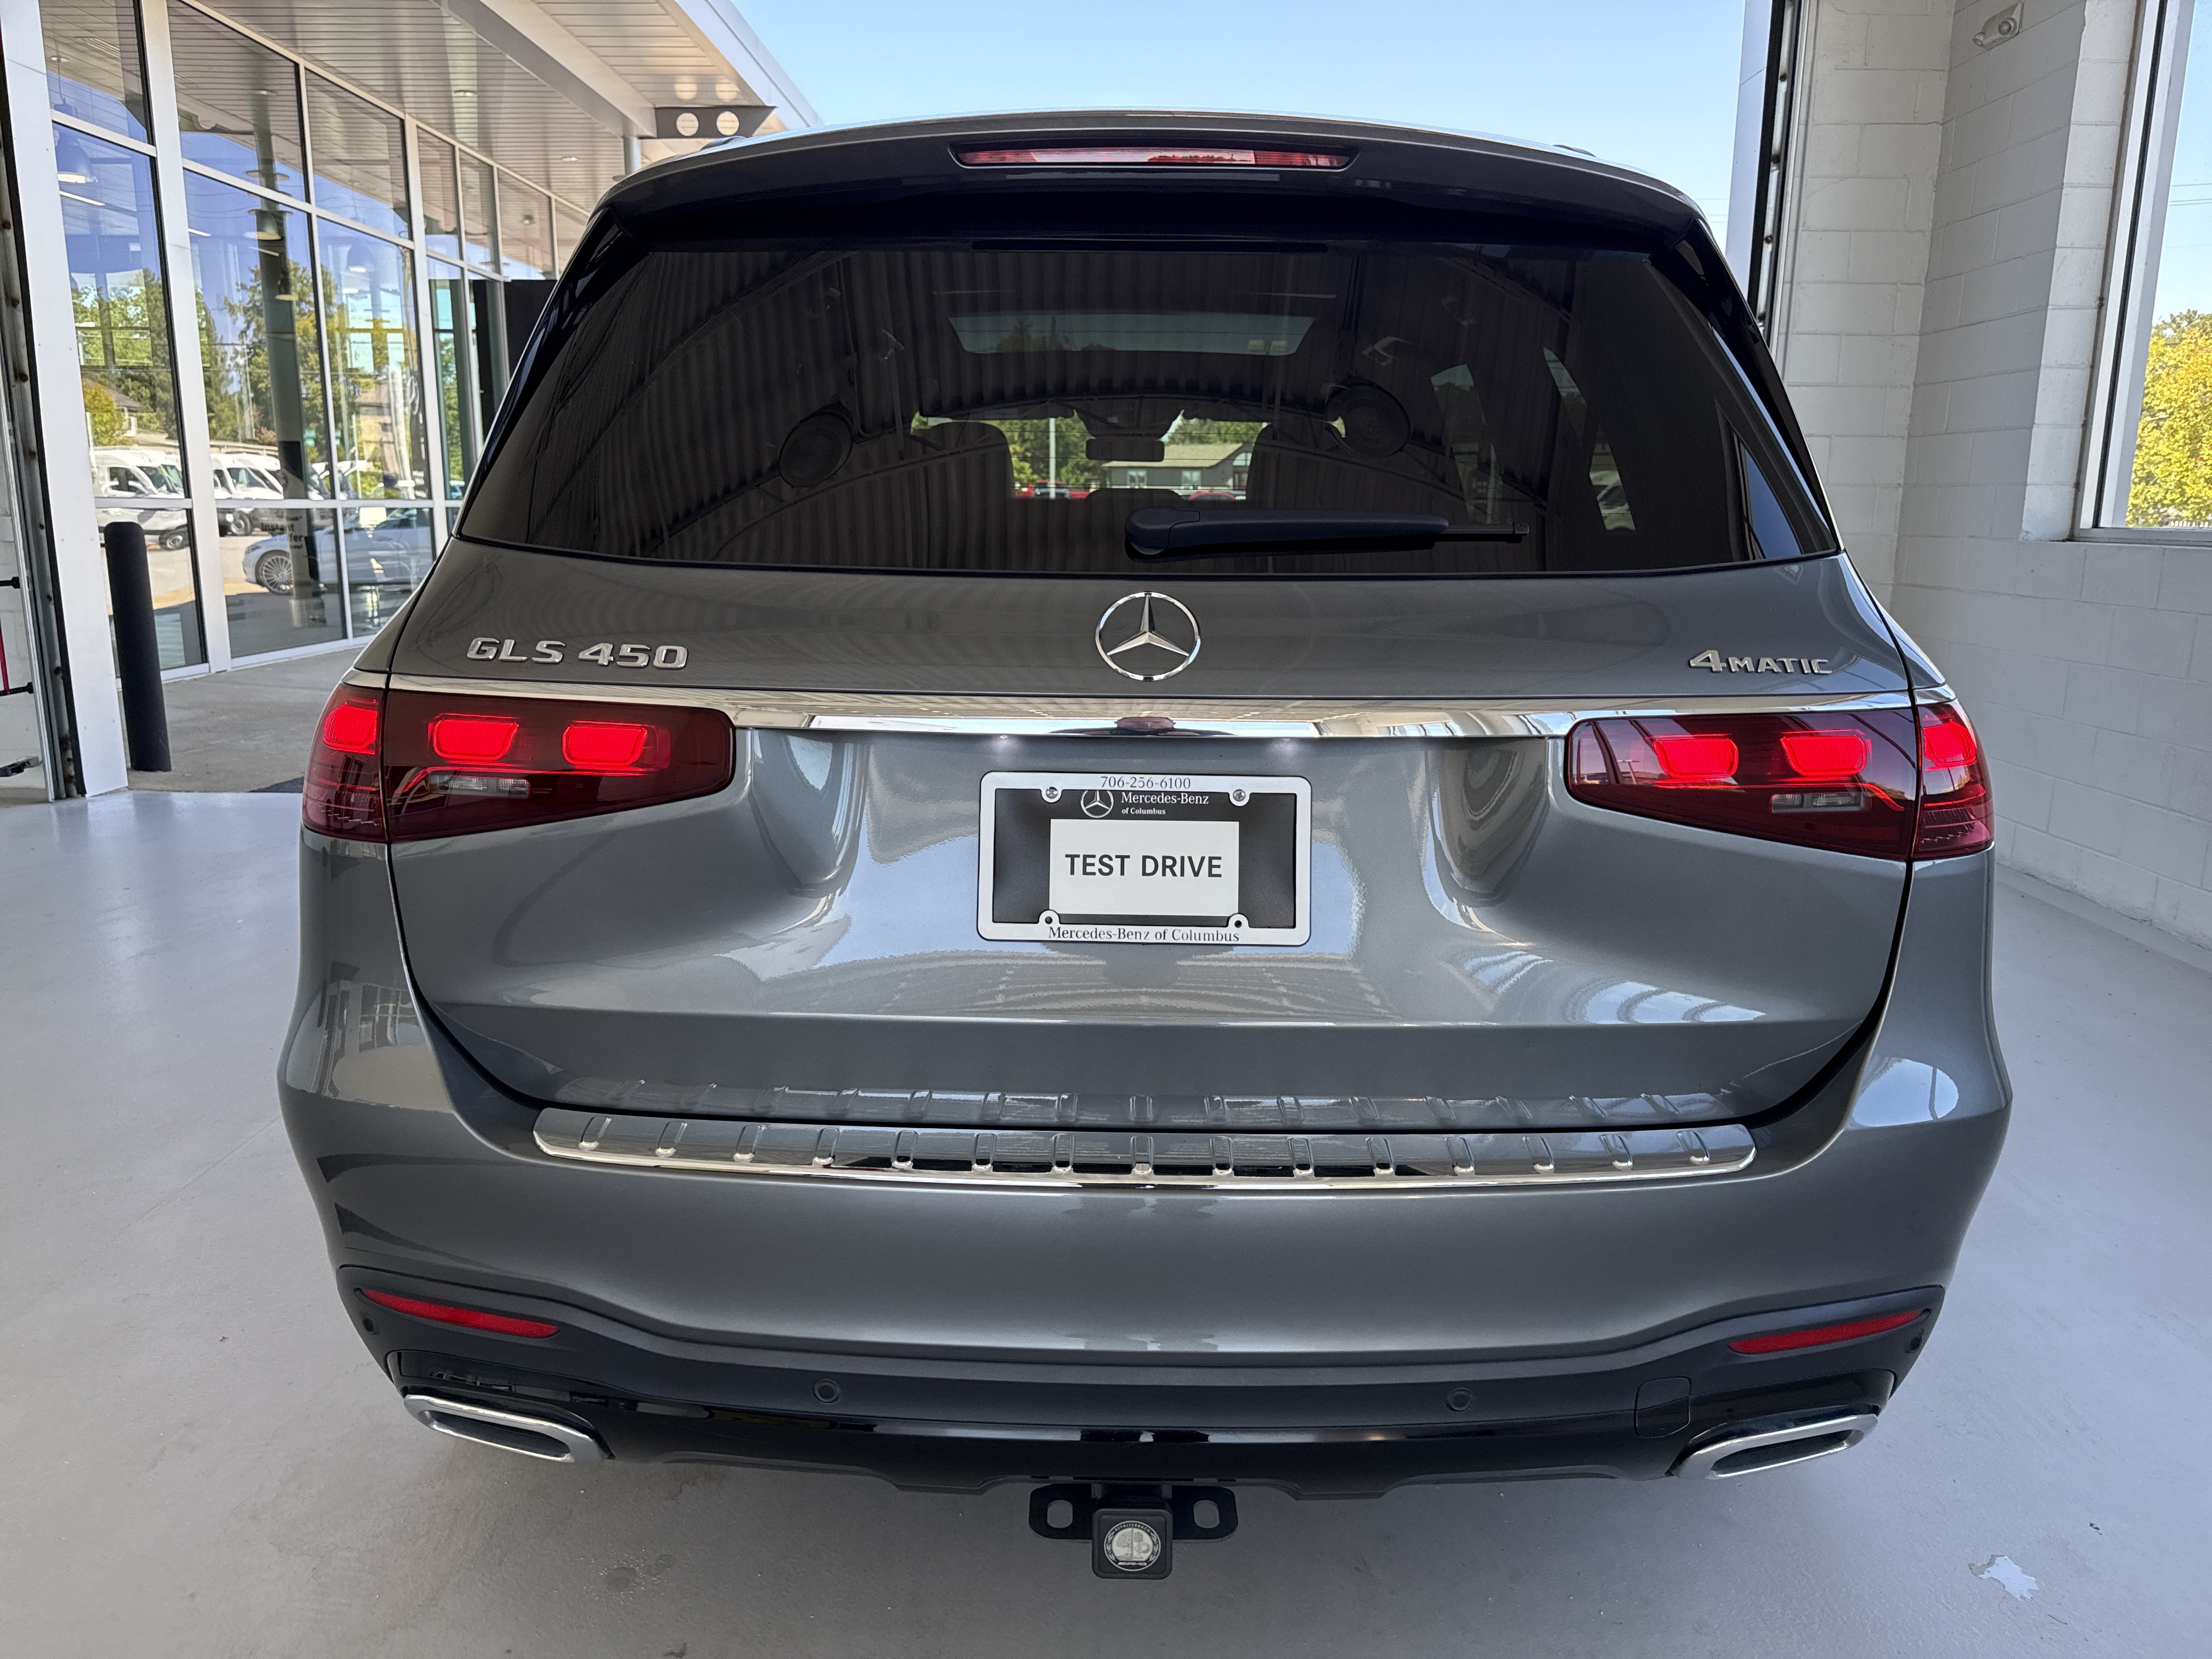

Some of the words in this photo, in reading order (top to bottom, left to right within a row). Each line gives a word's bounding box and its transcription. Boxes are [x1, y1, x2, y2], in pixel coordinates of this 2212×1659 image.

[467, 637, 566, 663] GLS
[578, 642, 689, 669] 450
[1689, 650, 1832, 674] 4MATIC
[1101, 776, 1191, 789] 706-256-6100
[1121, 792, 1209, 804] Mercedes-Benz
[1065, 854, 1130, 876] TEST
[1142, 855, 1222, 878] DRIVE
[1048, 926, 1150, 940] Mercedes-Benz
[1155, 928, 1169, 940] of
[1172, 929, 1239, 942] Columbus
